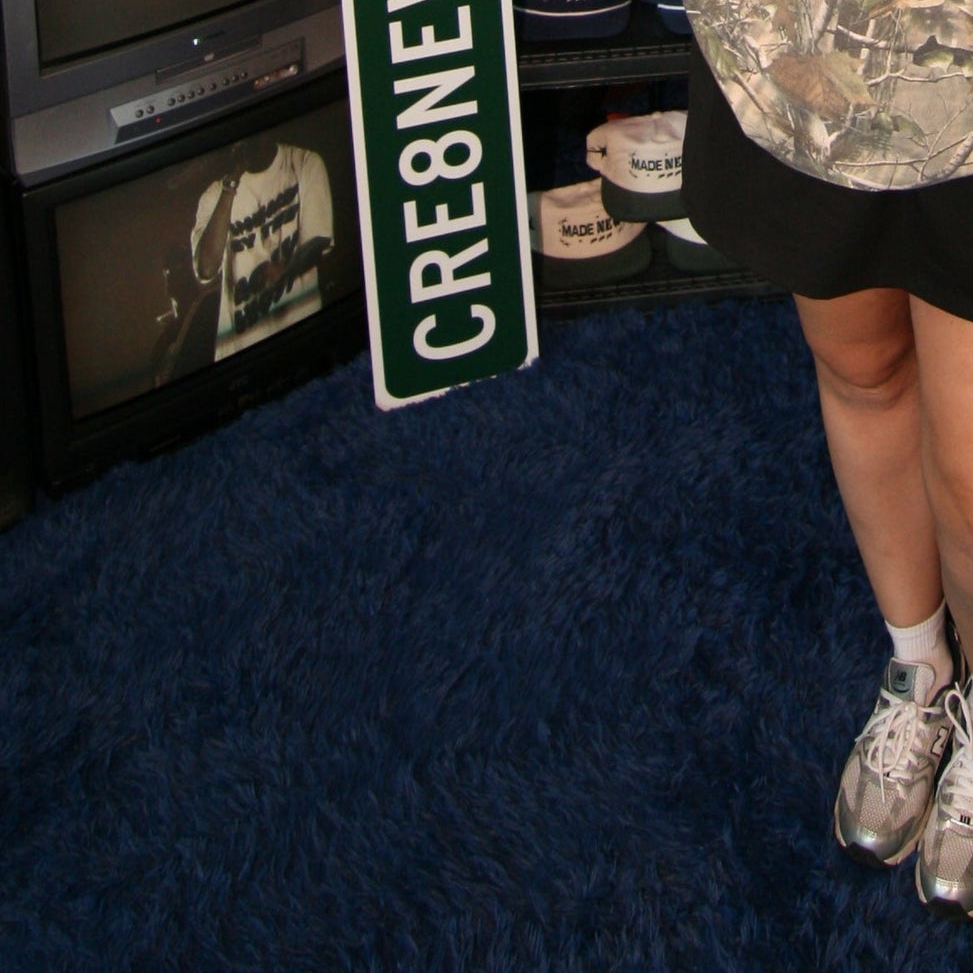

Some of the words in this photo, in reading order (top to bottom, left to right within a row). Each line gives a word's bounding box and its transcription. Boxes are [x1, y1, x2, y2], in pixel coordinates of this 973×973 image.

[631, 159, 662, 171] MADE
[664, 156, 683, 170] NE
[562, 223, 594, 237] MADE
